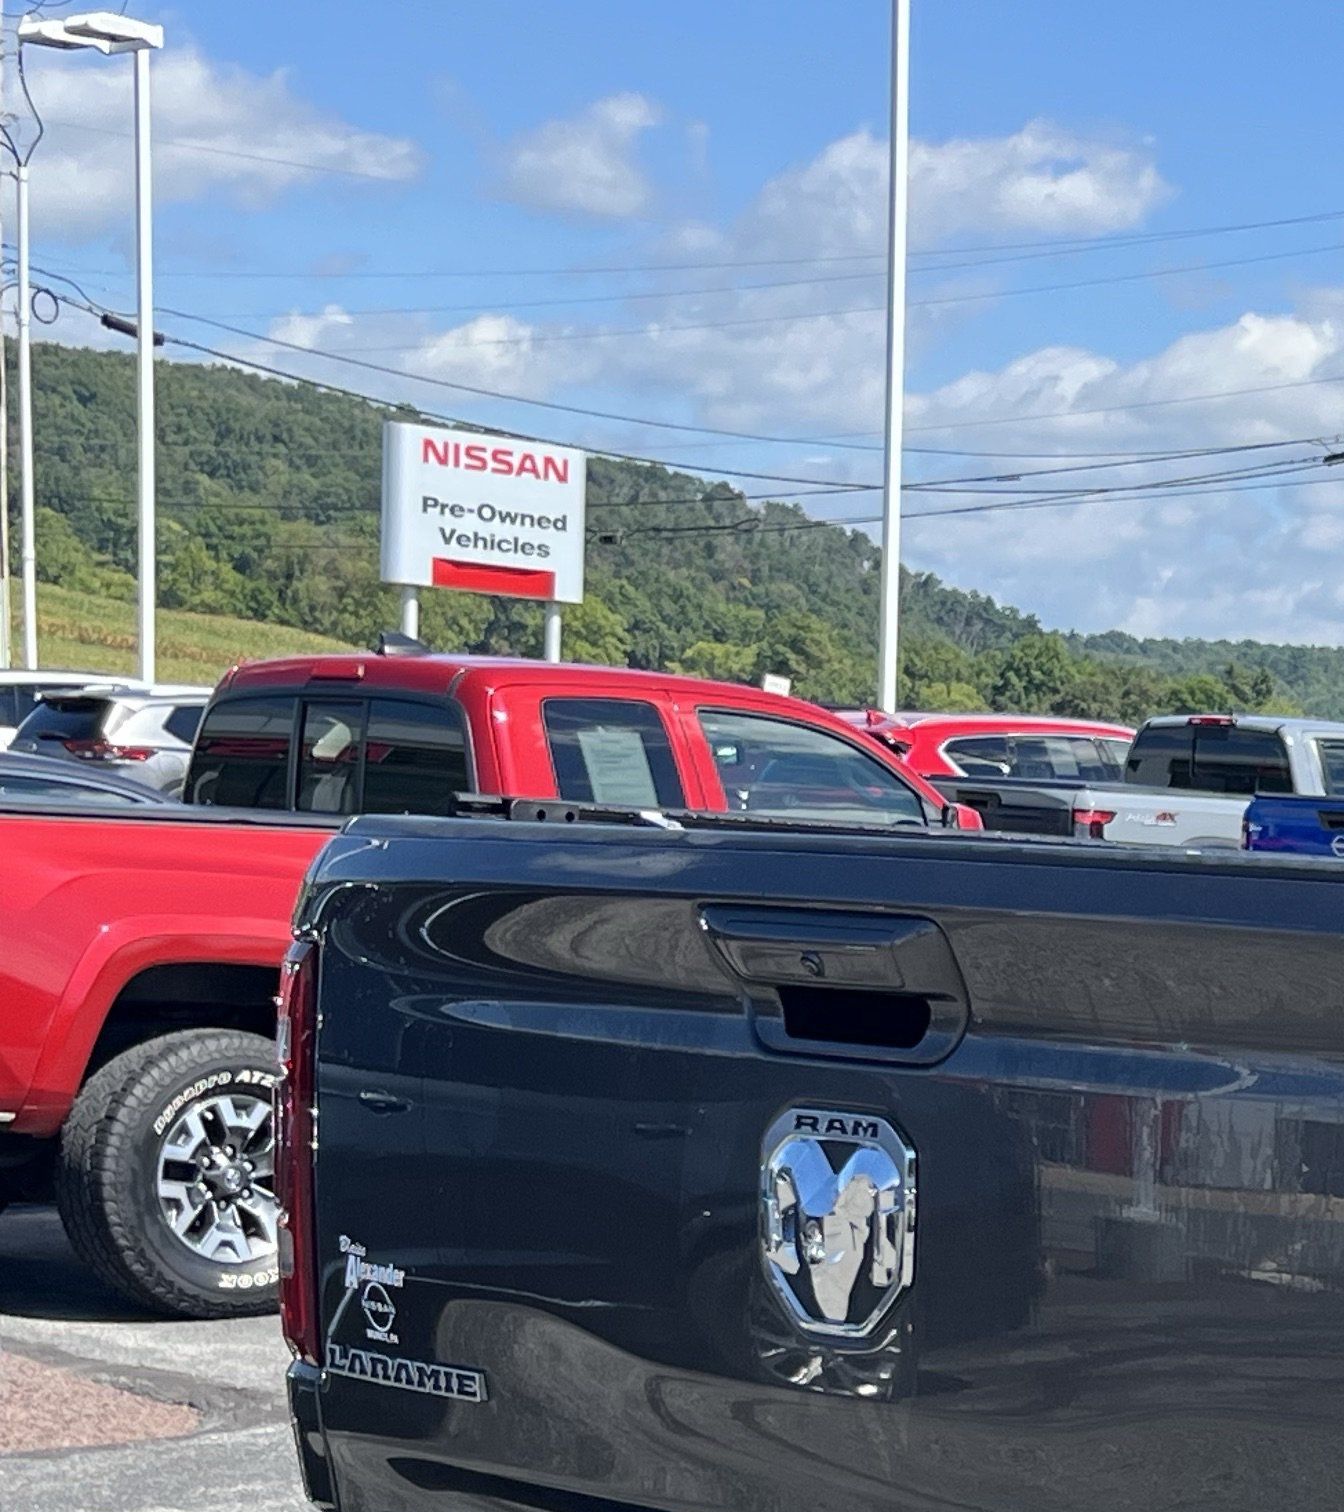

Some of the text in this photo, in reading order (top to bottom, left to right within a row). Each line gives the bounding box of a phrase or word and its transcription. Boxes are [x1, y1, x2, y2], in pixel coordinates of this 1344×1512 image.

[421, 437, 570, 484] NISSAN
[421, 495, 568, 532] Pre-Owned
[438, 526, 551, 558] Vehicles
[793, 1114, 880, 1139] RAM
[328, 1344, 481, 1402] LARAMIE
